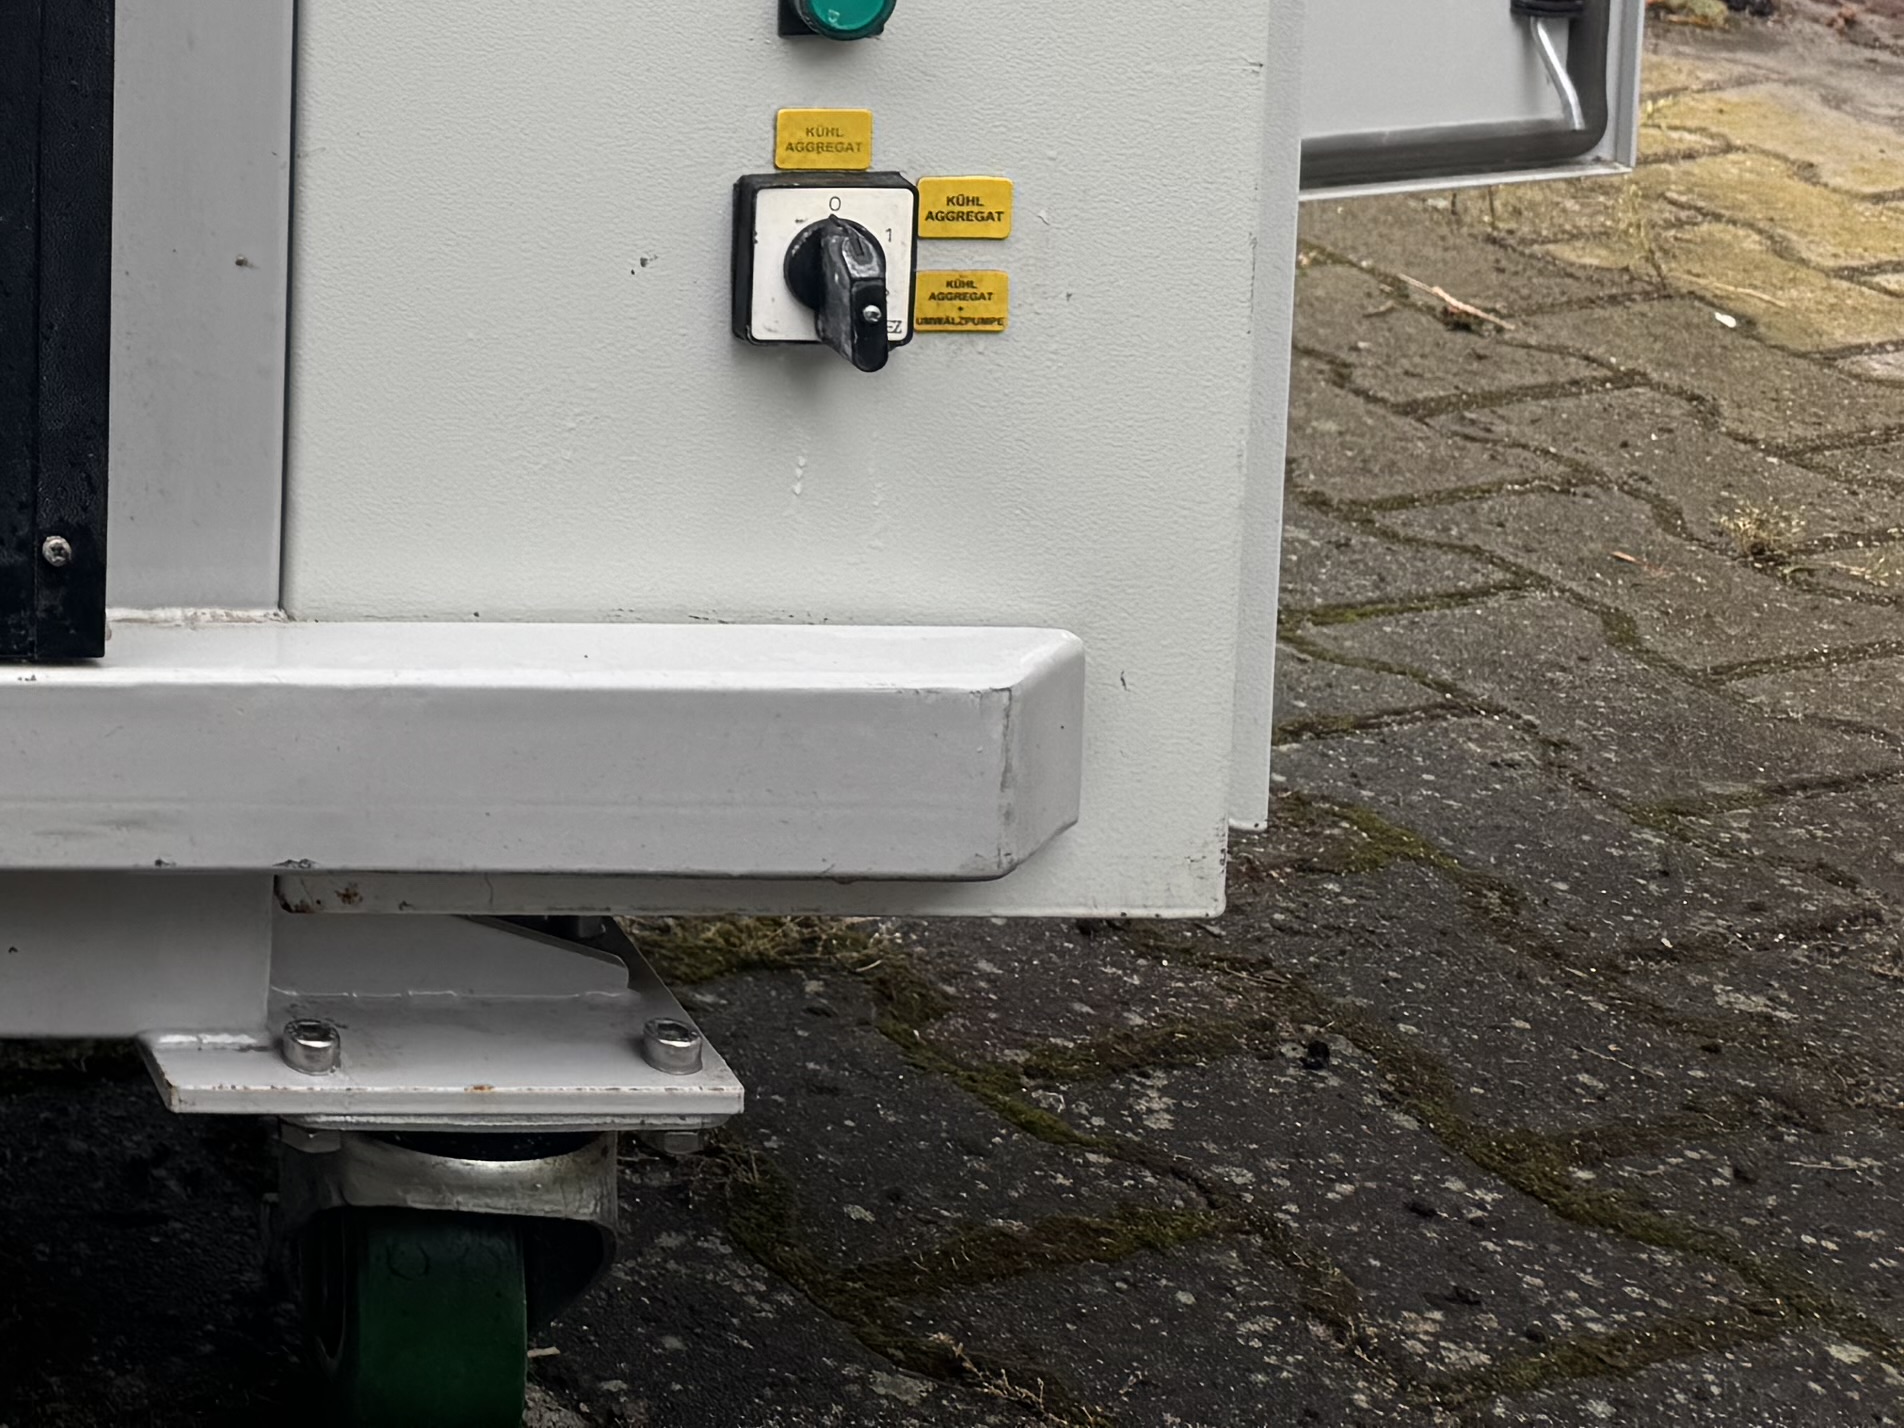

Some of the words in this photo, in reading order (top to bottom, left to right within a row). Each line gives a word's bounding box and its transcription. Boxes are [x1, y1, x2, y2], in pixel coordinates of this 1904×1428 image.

[805, 125, 845, 138] KÜHL
[785, 141, 864, 154] AGGREGAT
[828, 196, 842, 212] 0
[945, 194, 985, 207] KÜHL
[924, 211, 1005, 223] AGGREGAT
[945, 279, 978, 290] KÜHL
[928, 292, 994, 302] AGGREGAT
[915, 315, 1005, 327] UMWÄLZPUMPE
